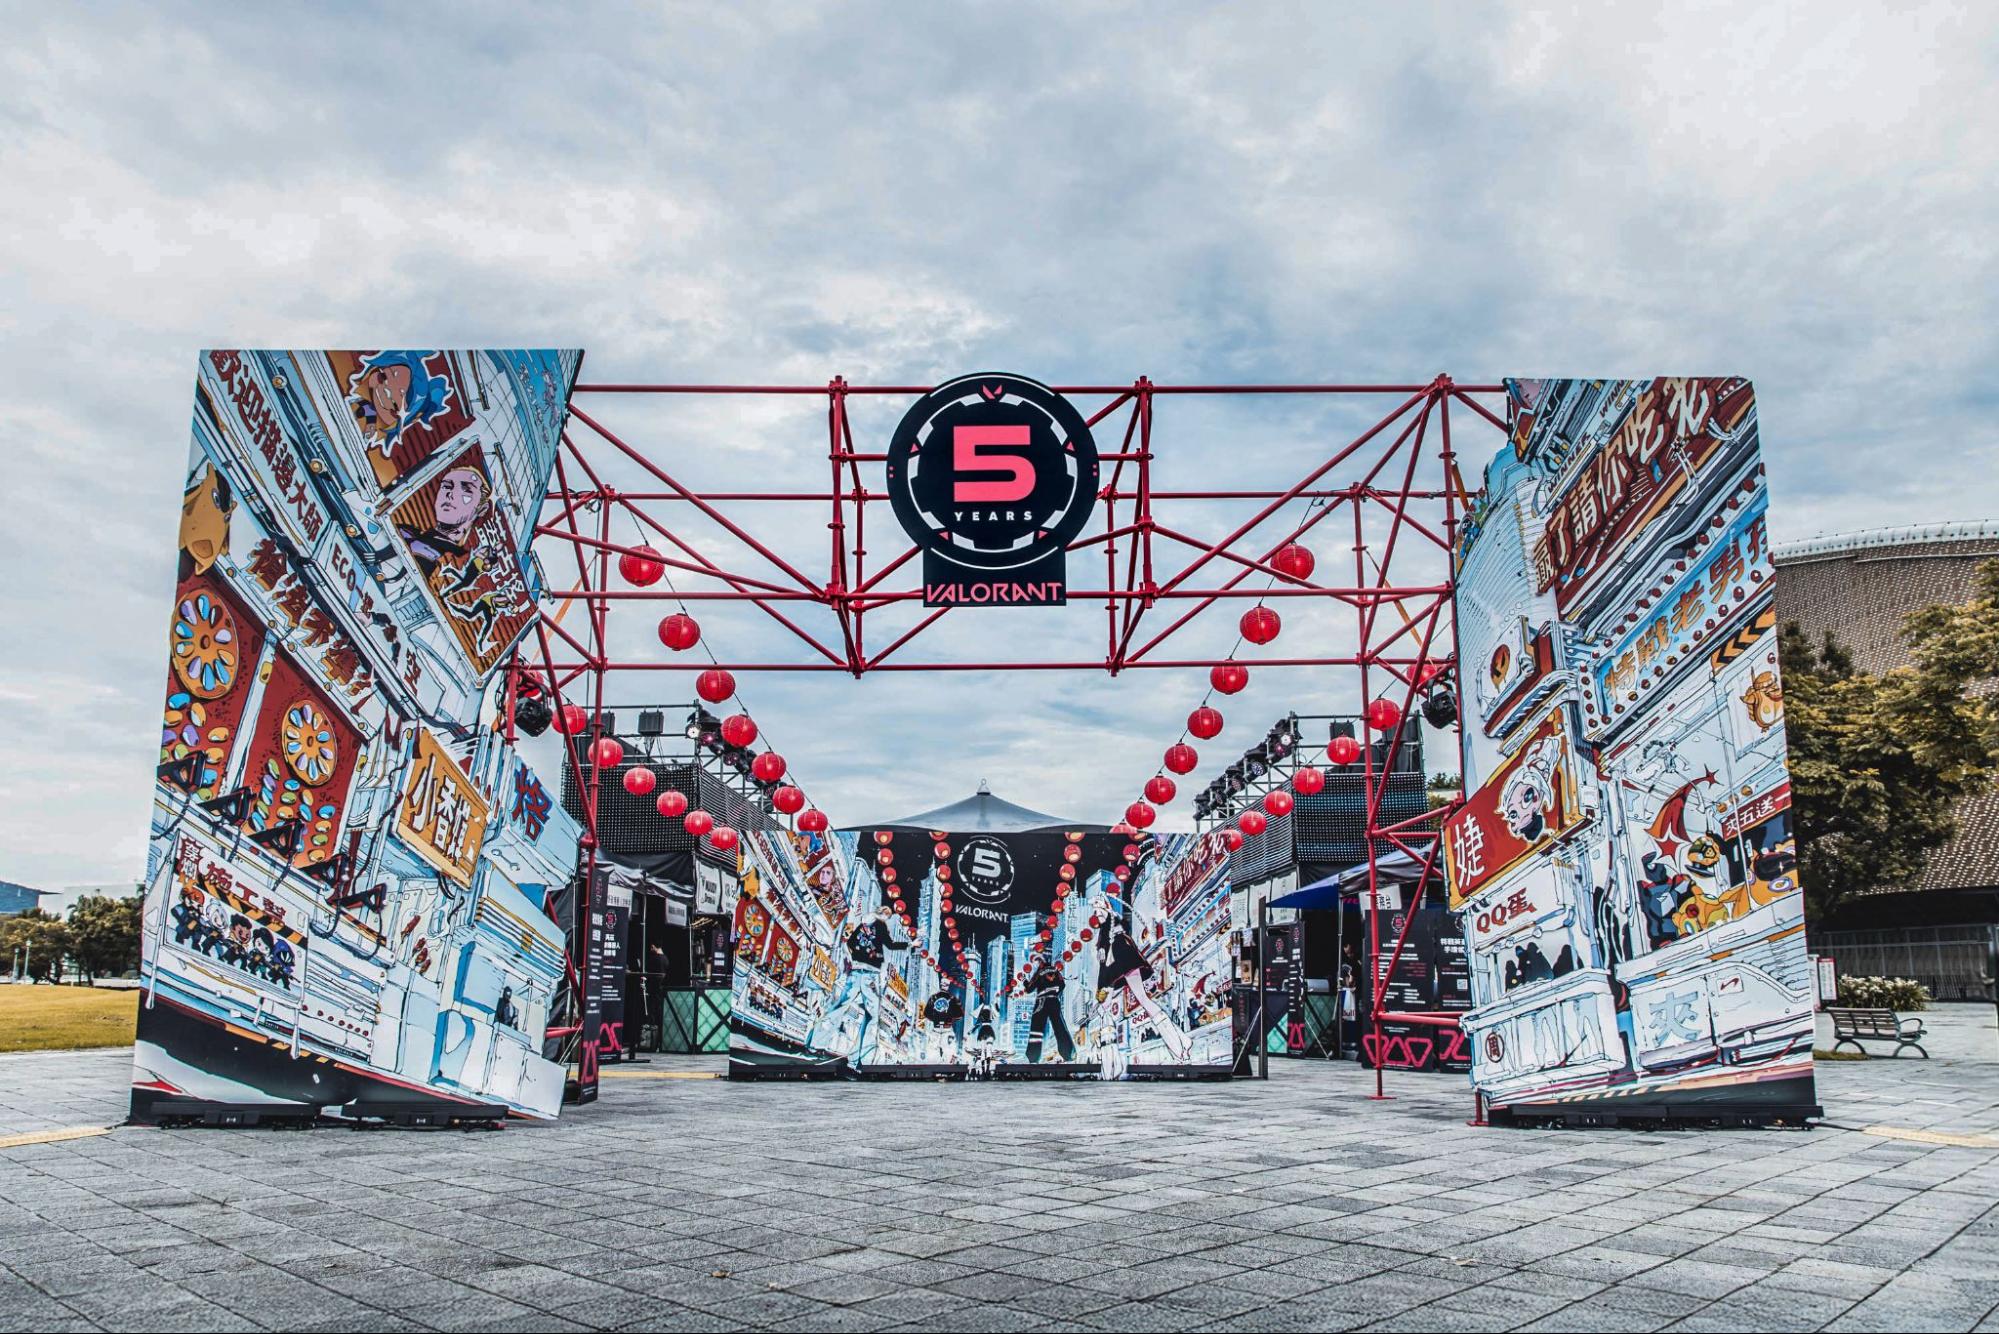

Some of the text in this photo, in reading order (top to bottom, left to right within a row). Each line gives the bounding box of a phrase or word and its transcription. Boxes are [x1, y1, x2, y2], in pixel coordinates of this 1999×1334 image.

[954, 425, 1036, 502] 5
[1547, 431, 1591, 493] WINNER
[954, 511, 1033, 521] YEARS
[927, 582, 1063, 603] VALORANT
[972, 848, 1001, 878] 5
[1454, 813, 1485, 889] 婕
[955, 904, 1010, 924] VALORANT
[1477, 887, 1537, 933] QQ蛋
